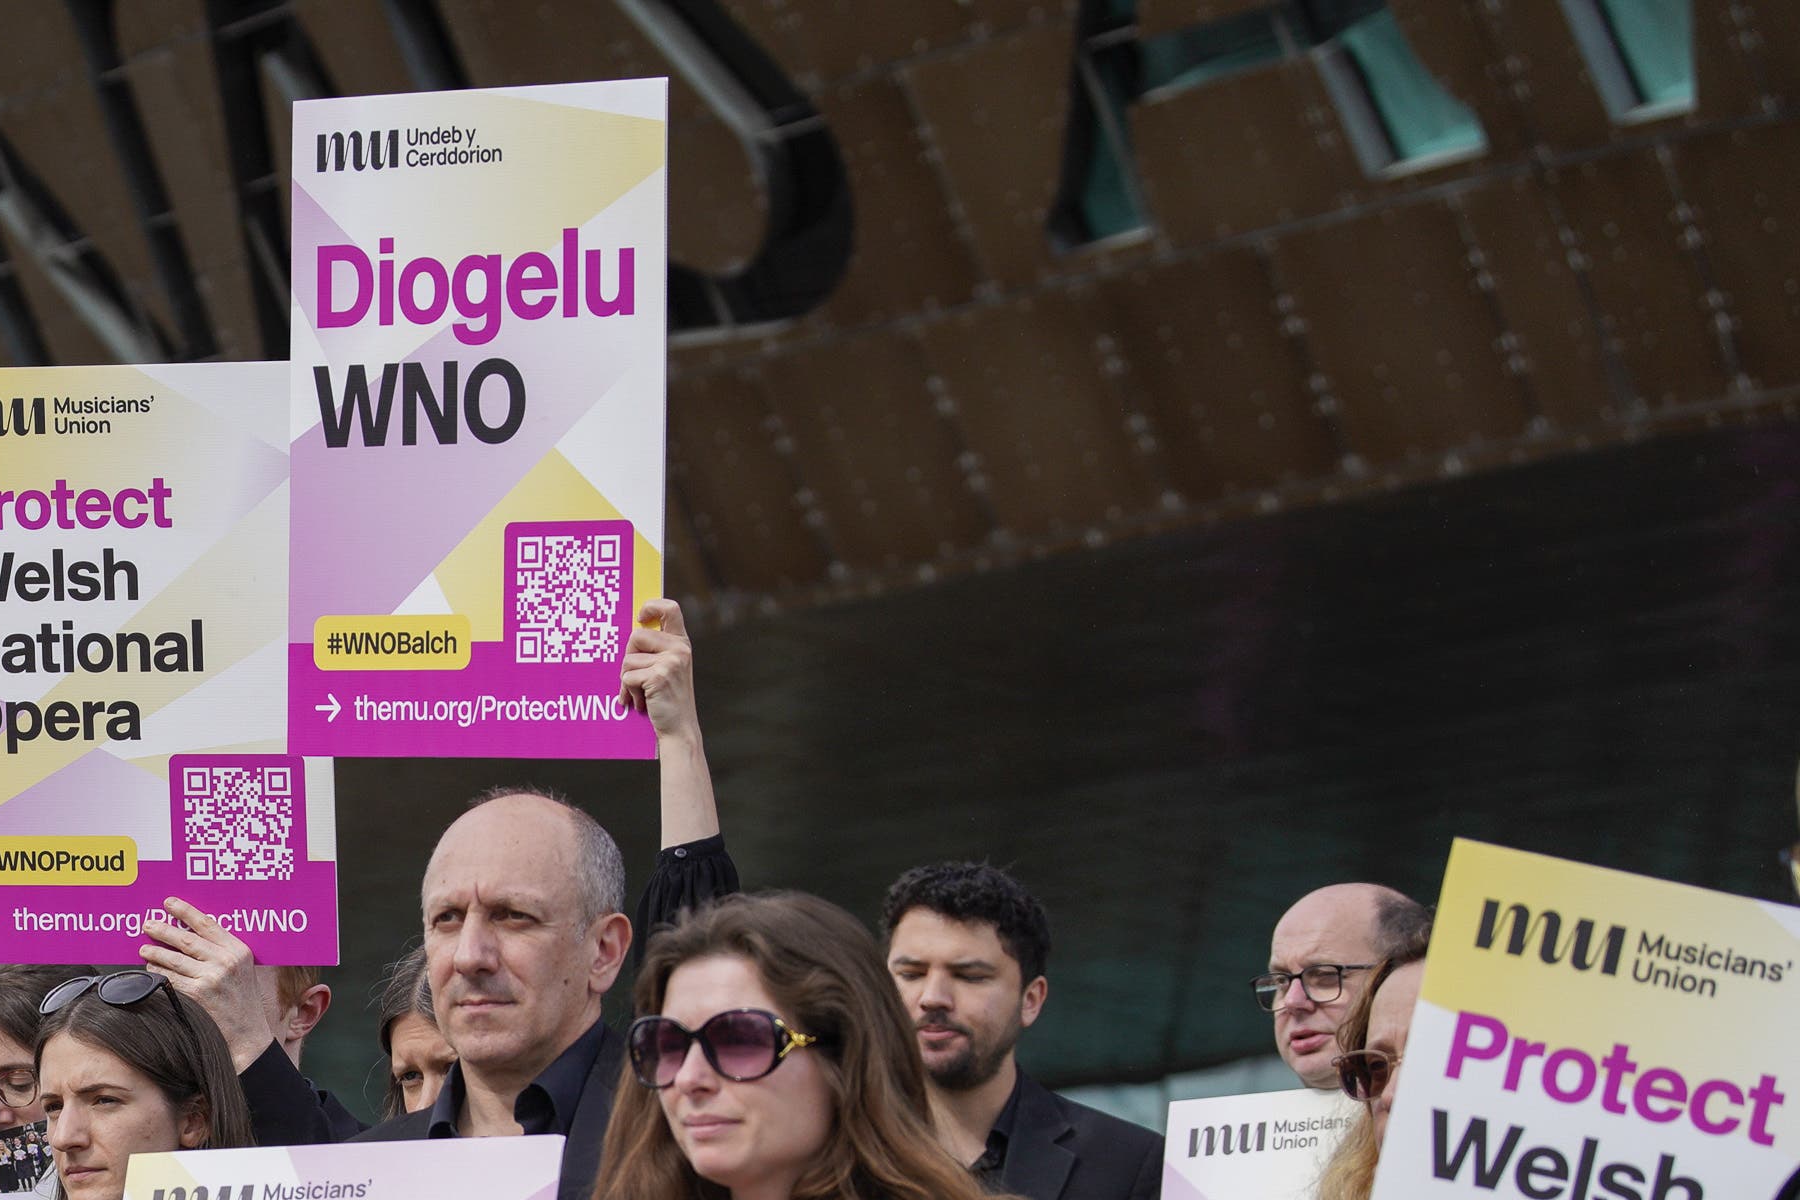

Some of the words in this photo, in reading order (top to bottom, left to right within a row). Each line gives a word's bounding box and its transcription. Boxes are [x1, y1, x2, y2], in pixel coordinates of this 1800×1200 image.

[406, 126, 460, 146] Undeb
[465, 128, 477, 150] y
[405, 145, 503, 168] Cerddorion
[316, 227, 636, 346] Diogelu
[53, 395, 155, 415] Musicians’
[312, 357, 527, 449] WNO
[54, 417, 111, 435] Union
[326, 631, 458, 658] #WNOBalch
[1637, 931, 1793, 984] Musicians’
[1632, 959, 1718, 999] Union
[1444, 1010, 1785, 1147] Protect
[1272, 1135, 1318, 1151] Union
